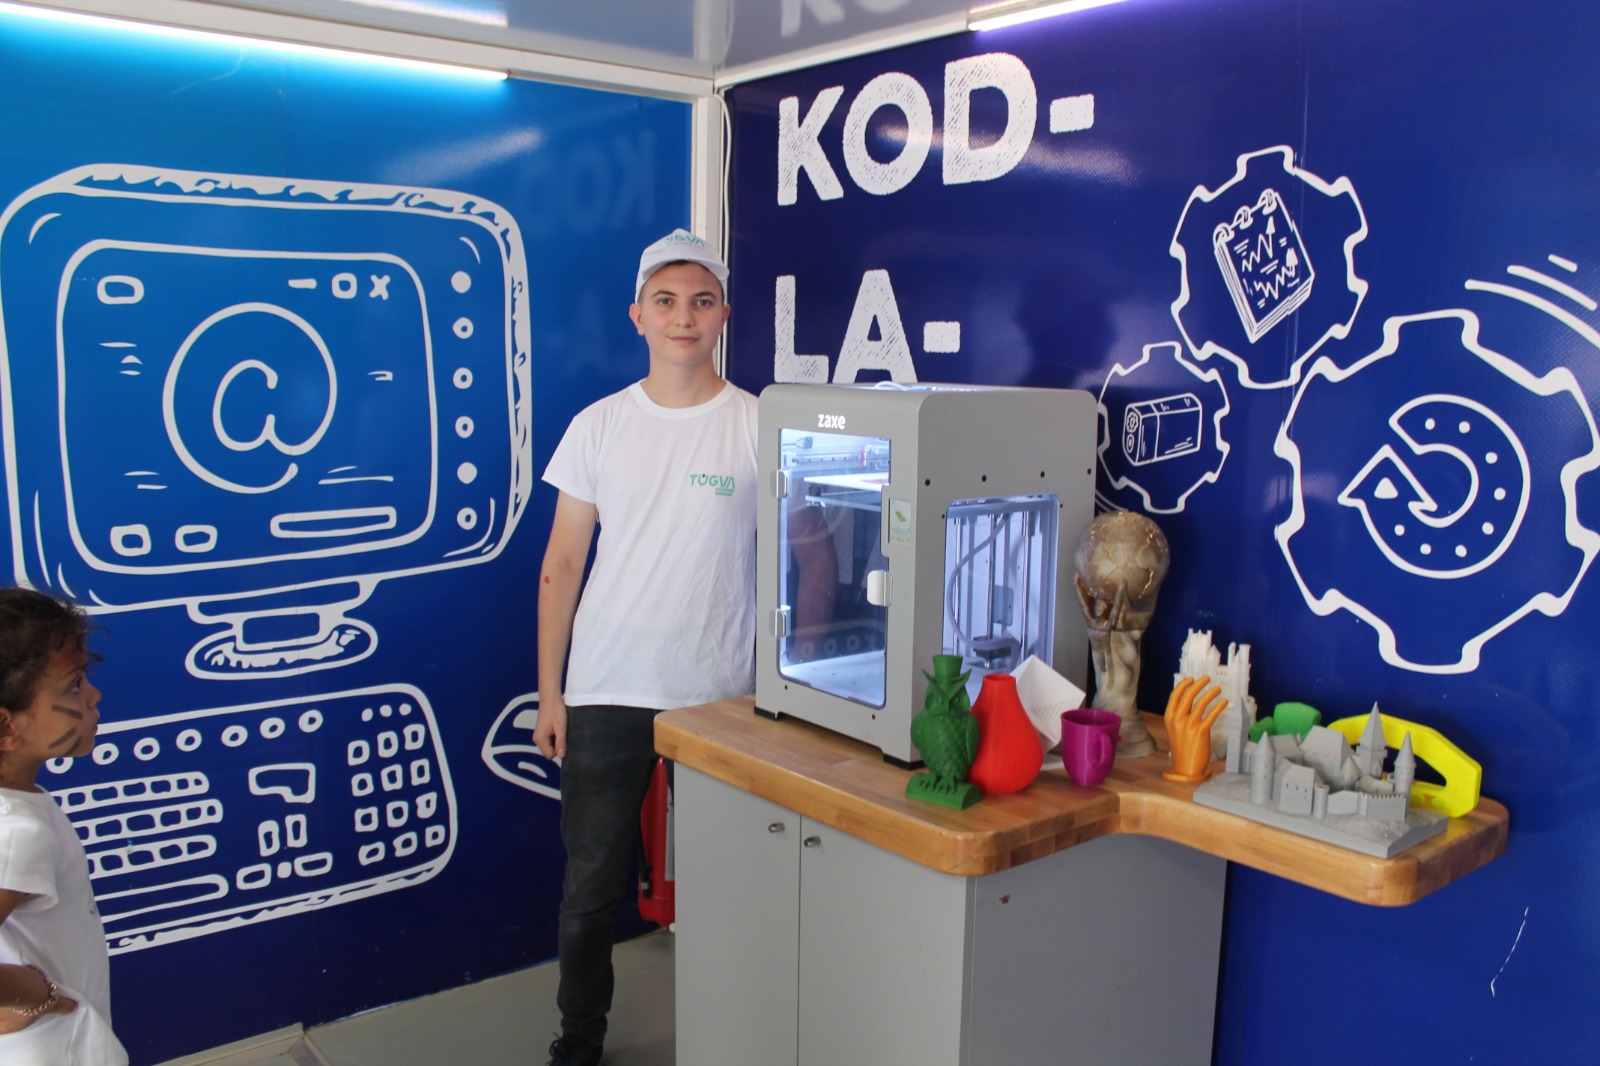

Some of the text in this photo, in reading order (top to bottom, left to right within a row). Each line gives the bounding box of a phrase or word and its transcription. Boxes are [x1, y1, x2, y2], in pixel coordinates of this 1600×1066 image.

[777, 52, 1095, 206] KOD-
[774, 268, 961, 384] LA-
[817, 413, 846, 430] zaxe
